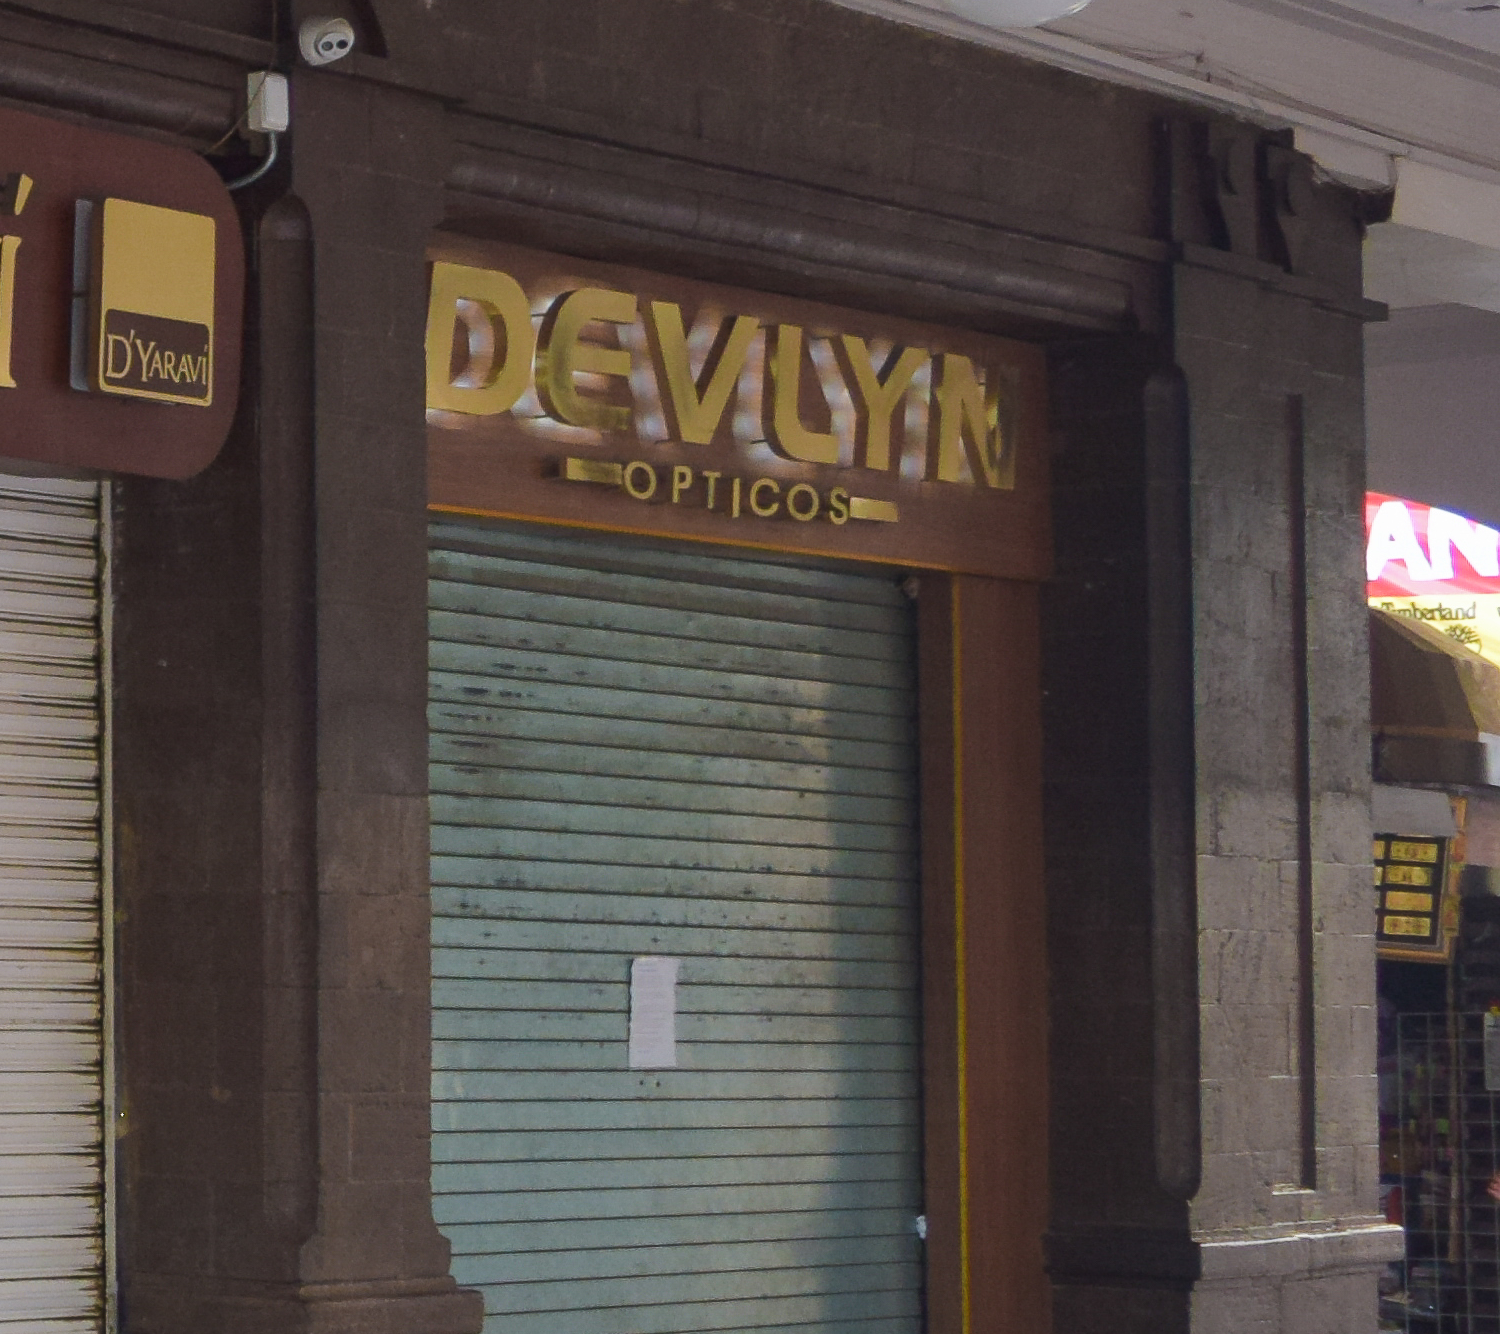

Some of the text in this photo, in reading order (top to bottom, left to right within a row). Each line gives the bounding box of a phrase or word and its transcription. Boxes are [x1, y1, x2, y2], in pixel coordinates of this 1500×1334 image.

[425, 261, 1016, 491] DEVLYN
[623, 460, 851, 525] OPTICOS
[1380, 601, 1477, 621] Tmberland
